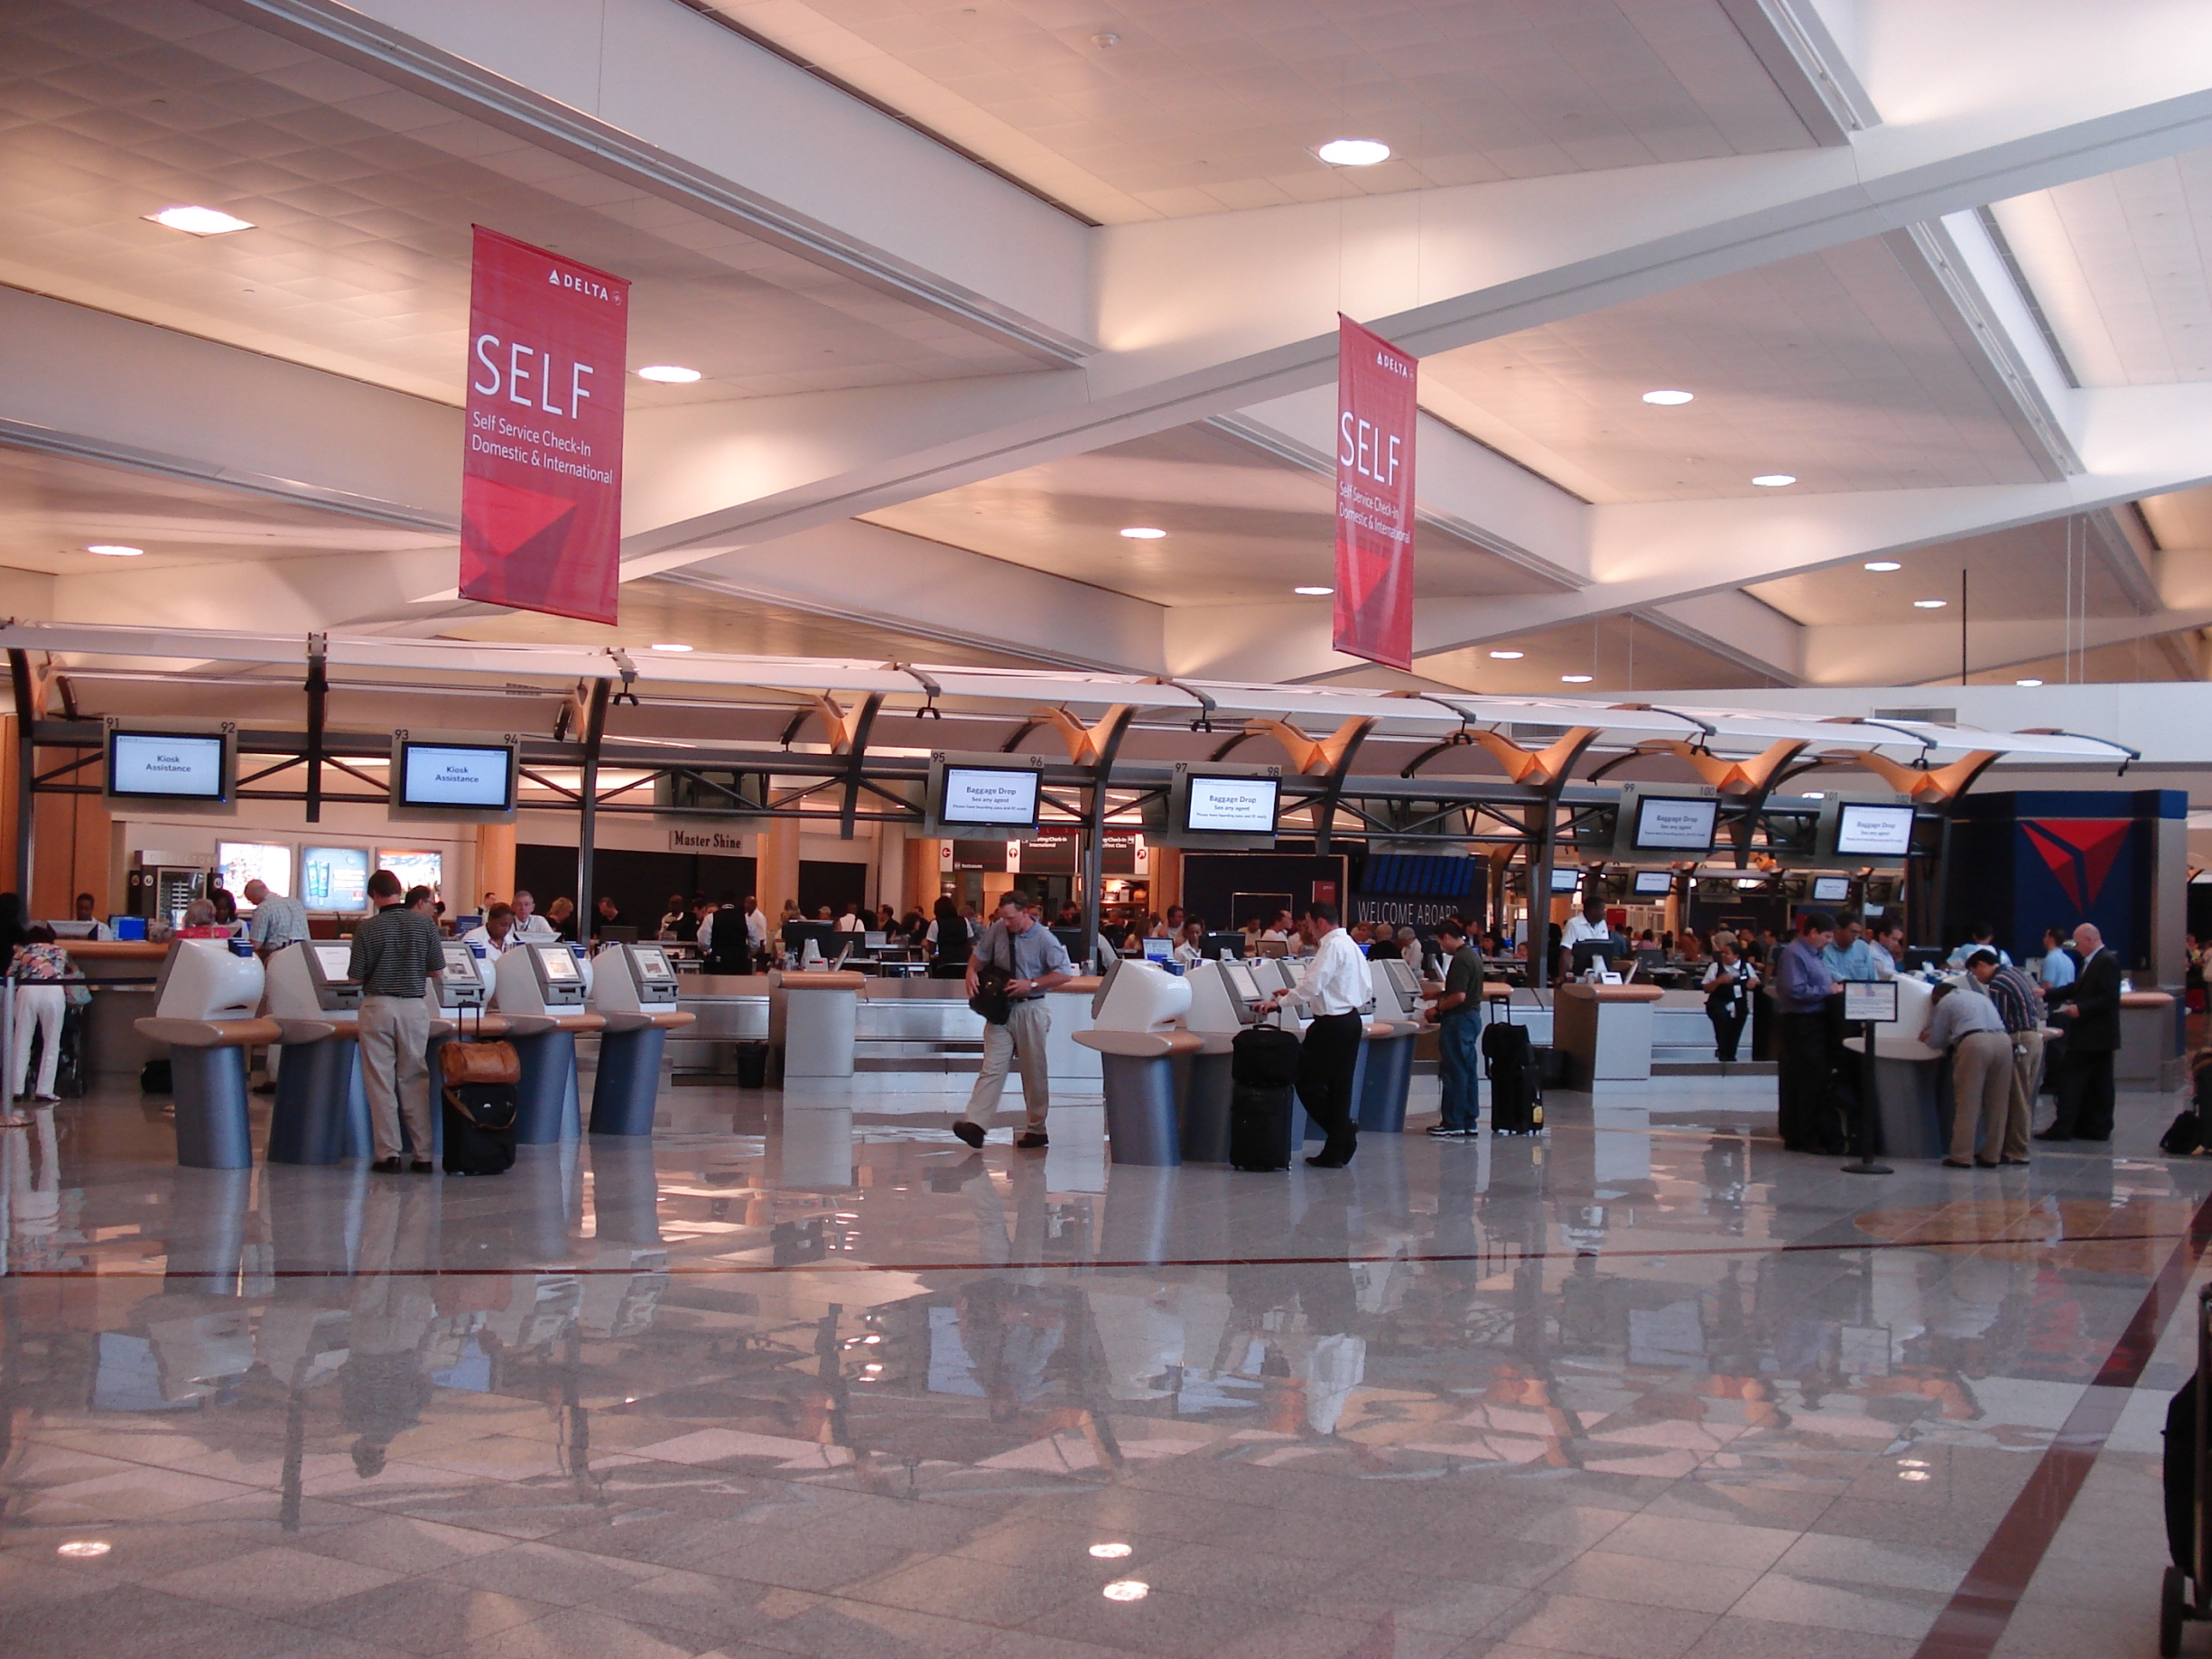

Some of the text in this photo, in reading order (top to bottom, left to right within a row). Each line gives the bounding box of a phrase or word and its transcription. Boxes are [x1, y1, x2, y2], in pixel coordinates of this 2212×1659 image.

[564, 274, 609, 301] DELTA
[1384, 355, 1408, 377] DELTA
[475, 333, 594, 419] SELF
[473, 411, 591, 457] Self Service Check-In
[1341, 411, 1400, 486] SELF
[472, 434, 613, 485] Domestic & International
[1340, 480, 1399, 519] Self Service Check-In
[1339, 501, 1411, 544] Domestic & International
[107, 717, 119, 729] 91
[221, 722, 236, 733] 92
[395, 729, 409, 740] 93
[504, 733, 518, 744] 94
[157, 755, 180, 763] Kiosk
[933, 752, 945, 763] 95
[1030, 756, 1043, 767] 96
[145, 764, 191, 772] Assistance
[446, 766, 469, 774] Kiosk
[1176, 763, 1188, 773] 97
[1268, 767, 1279, 777] 98
[435, 775, 479, 783] Assistance
[966, 786, 1017, 796] Baggage Drop
[1624, 783, 1635, 792] 99
[1700, 787, 1715, 796] 100
[1209, 795, 1238, 804] Baggage
[674, 830, 741, 848] Master Shine
[1358, 900, 1414, 925] WELCOME
